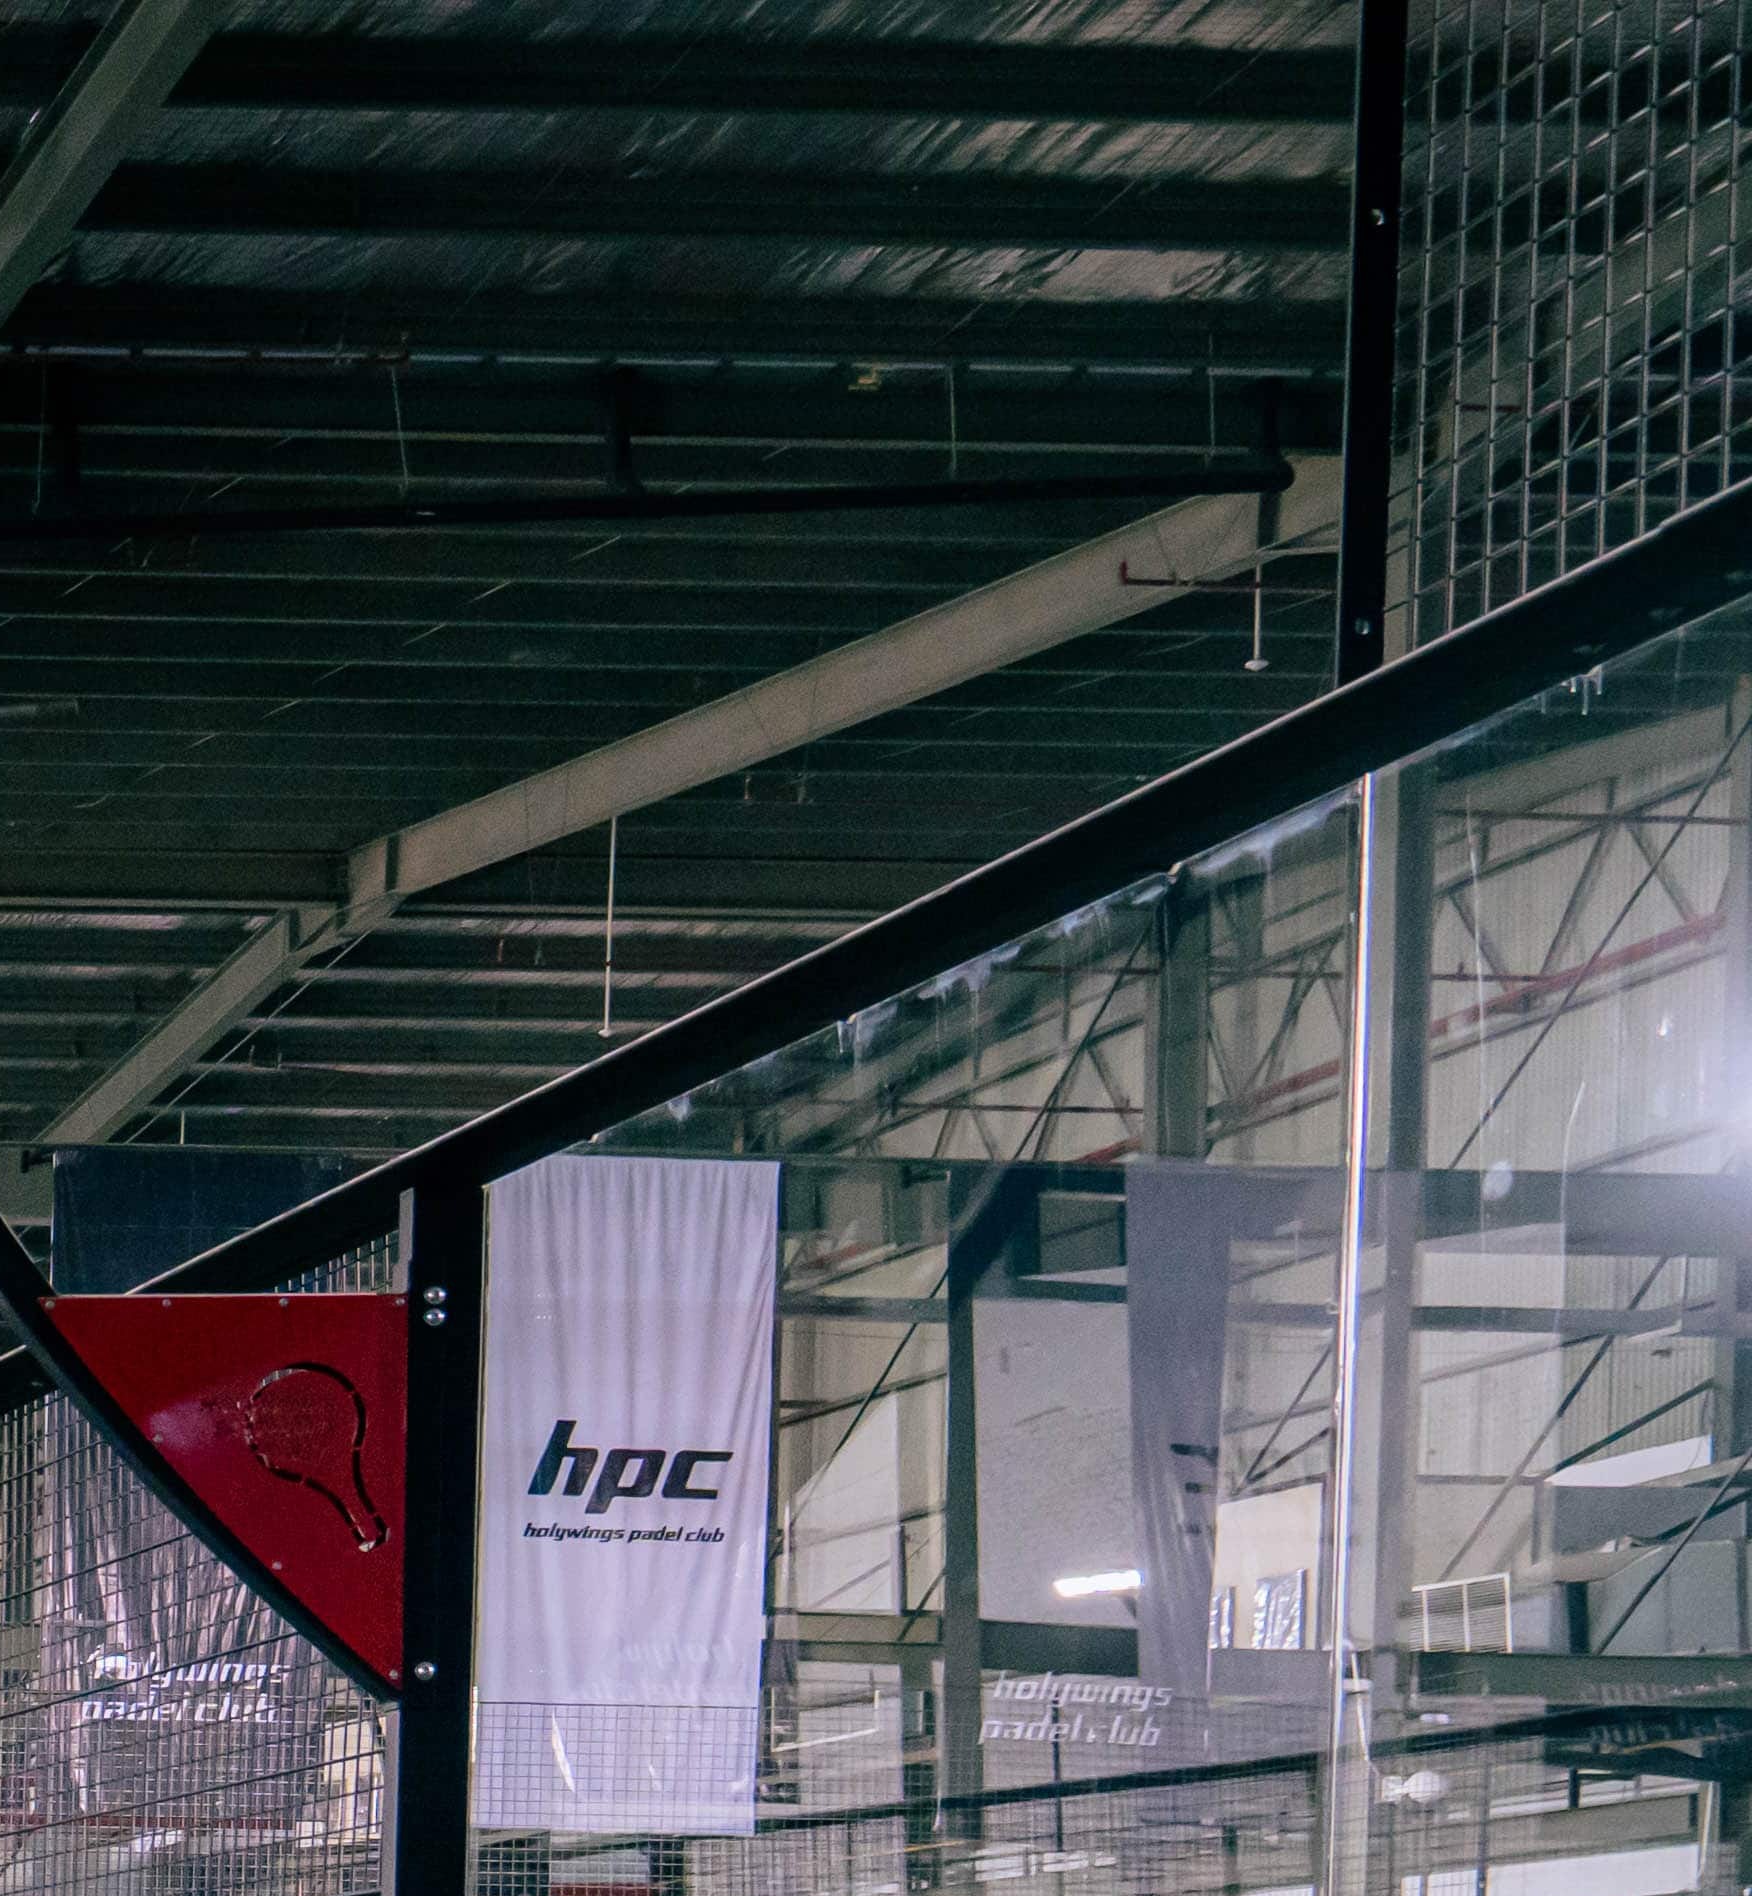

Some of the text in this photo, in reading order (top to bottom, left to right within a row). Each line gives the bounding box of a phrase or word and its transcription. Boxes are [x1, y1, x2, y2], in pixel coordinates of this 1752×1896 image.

[528, 1420, 733, 1514] hpc
[523, 1522, 725, 1543] holywings padel club
[994, 1670, 1173, 1712] holywings
